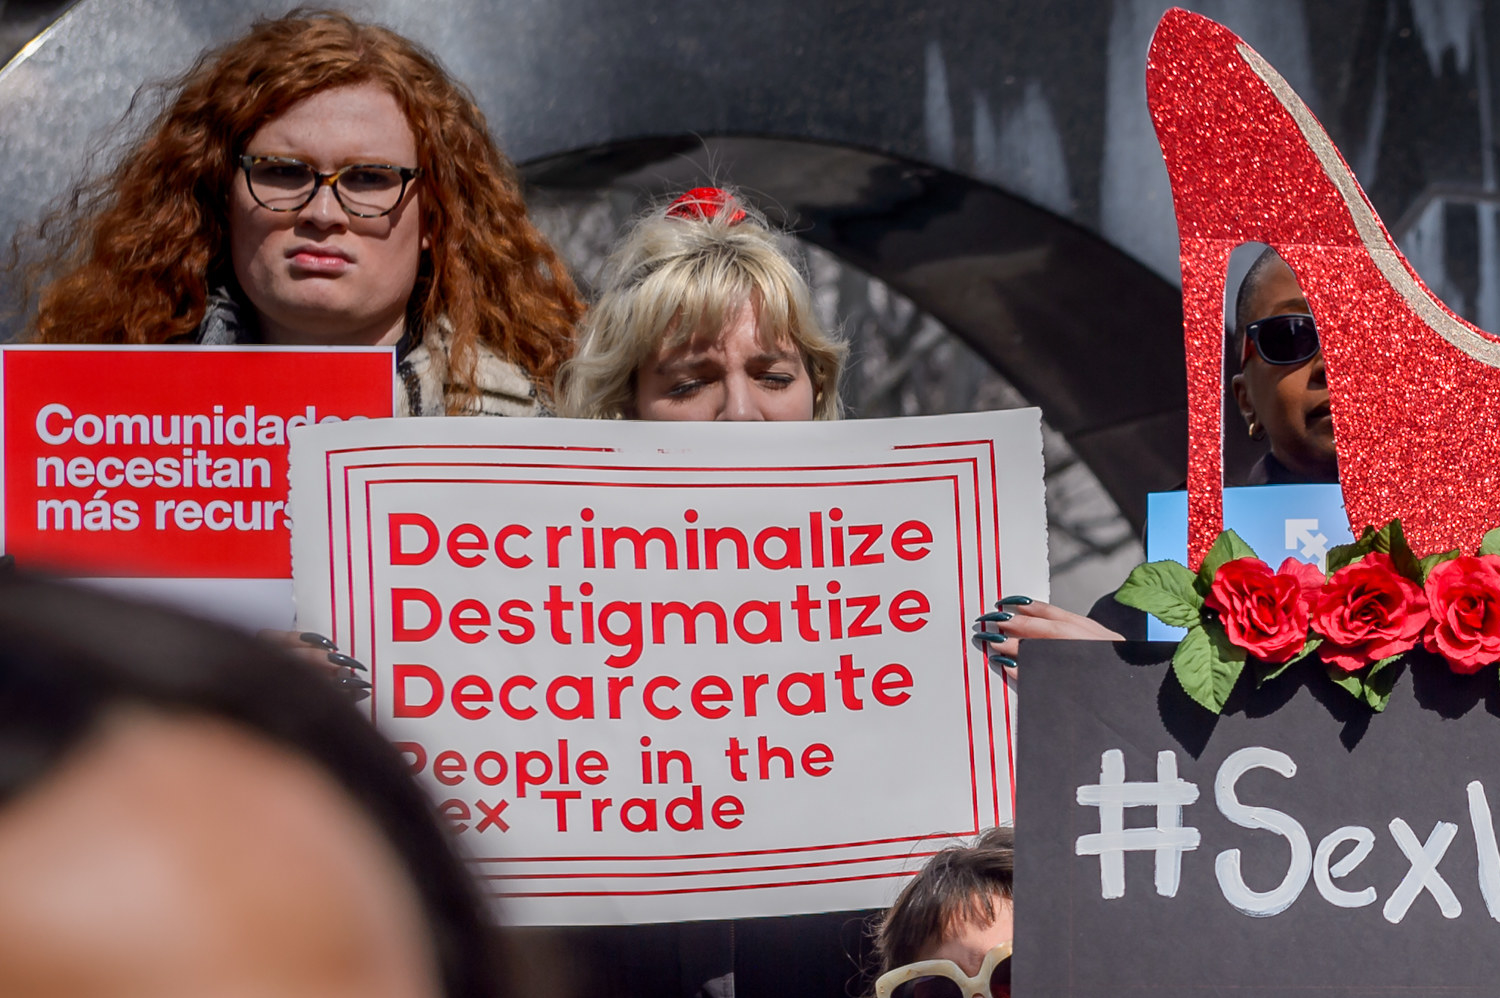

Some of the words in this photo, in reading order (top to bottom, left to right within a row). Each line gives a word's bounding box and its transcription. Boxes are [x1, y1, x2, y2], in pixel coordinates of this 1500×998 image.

[36, 447, 272, 489] necesitan
[36, 489, 141, 532] más
[387, 506, 934, 571] Decriminalize
[389, 579, 932, 670] Destigmatize
[391, 653, 915, 722] Decarcerate
[639, 735, 694, 787] in
[724, 735, 836, 783] the
[437, 798, 510, 834] ex
[539, 784, 746, 834] Trade
